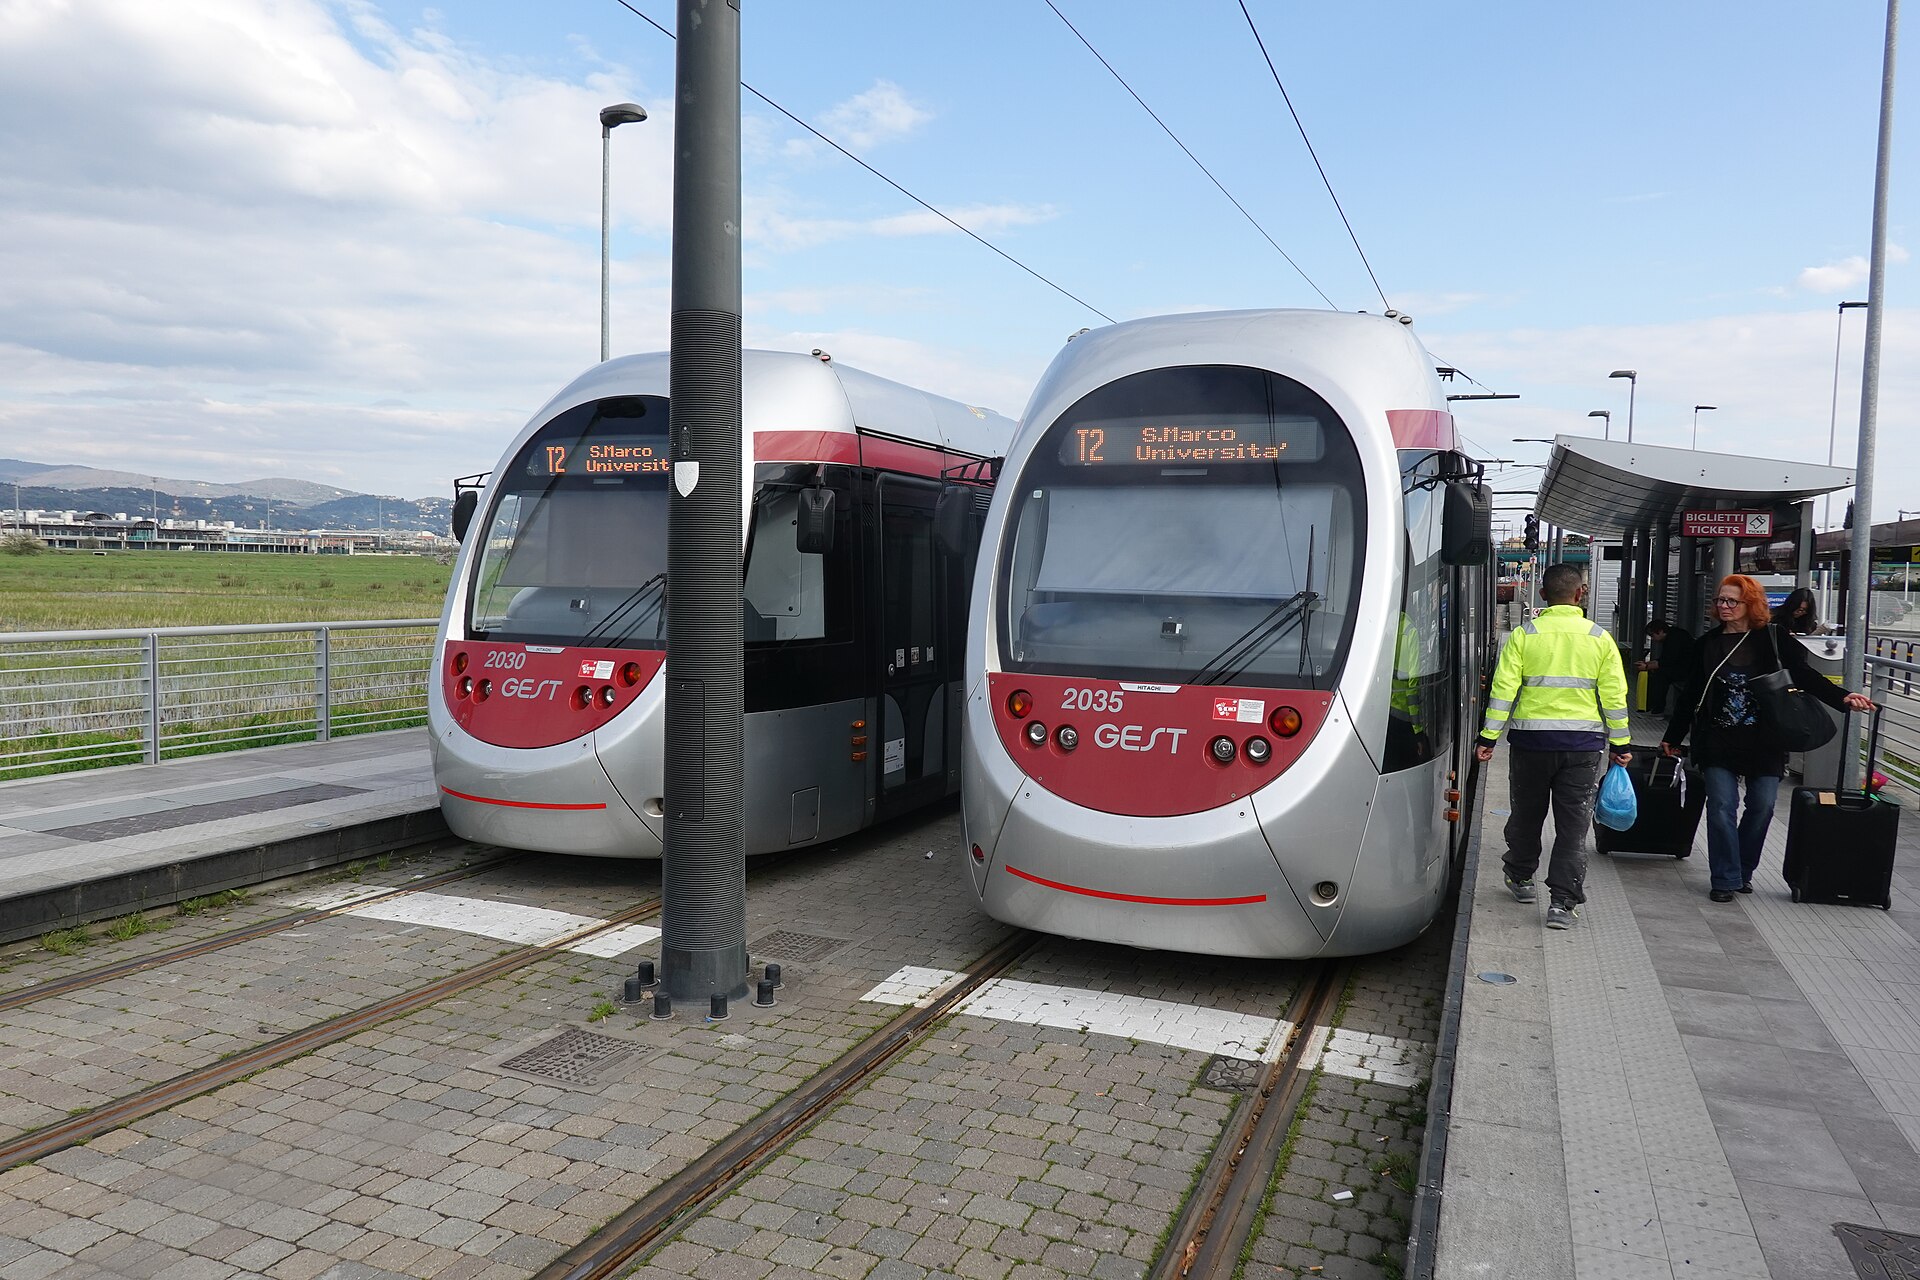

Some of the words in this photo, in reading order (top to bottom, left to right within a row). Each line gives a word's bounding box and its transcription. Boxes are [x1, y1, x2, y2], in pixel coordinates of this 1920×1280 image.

[1142, 427, 1236, 442] S.Marco
[589, 445, 653, 458] S.Marco
[1076, 428, 1104, 462] T2
[546, 446, 566, 473] T2
[586, 458, 670, 472] Universit
[1686, 513, 1744, 522] BIGLIETTI
[1689, 525, 1740, 534] TICKETS
[484, 650, 527, 670] 2030
[501, 677, 563, 700] GEST
[1061, 687, 1124, 713] 2035
[1094, 723, 1188, 754] GEST
